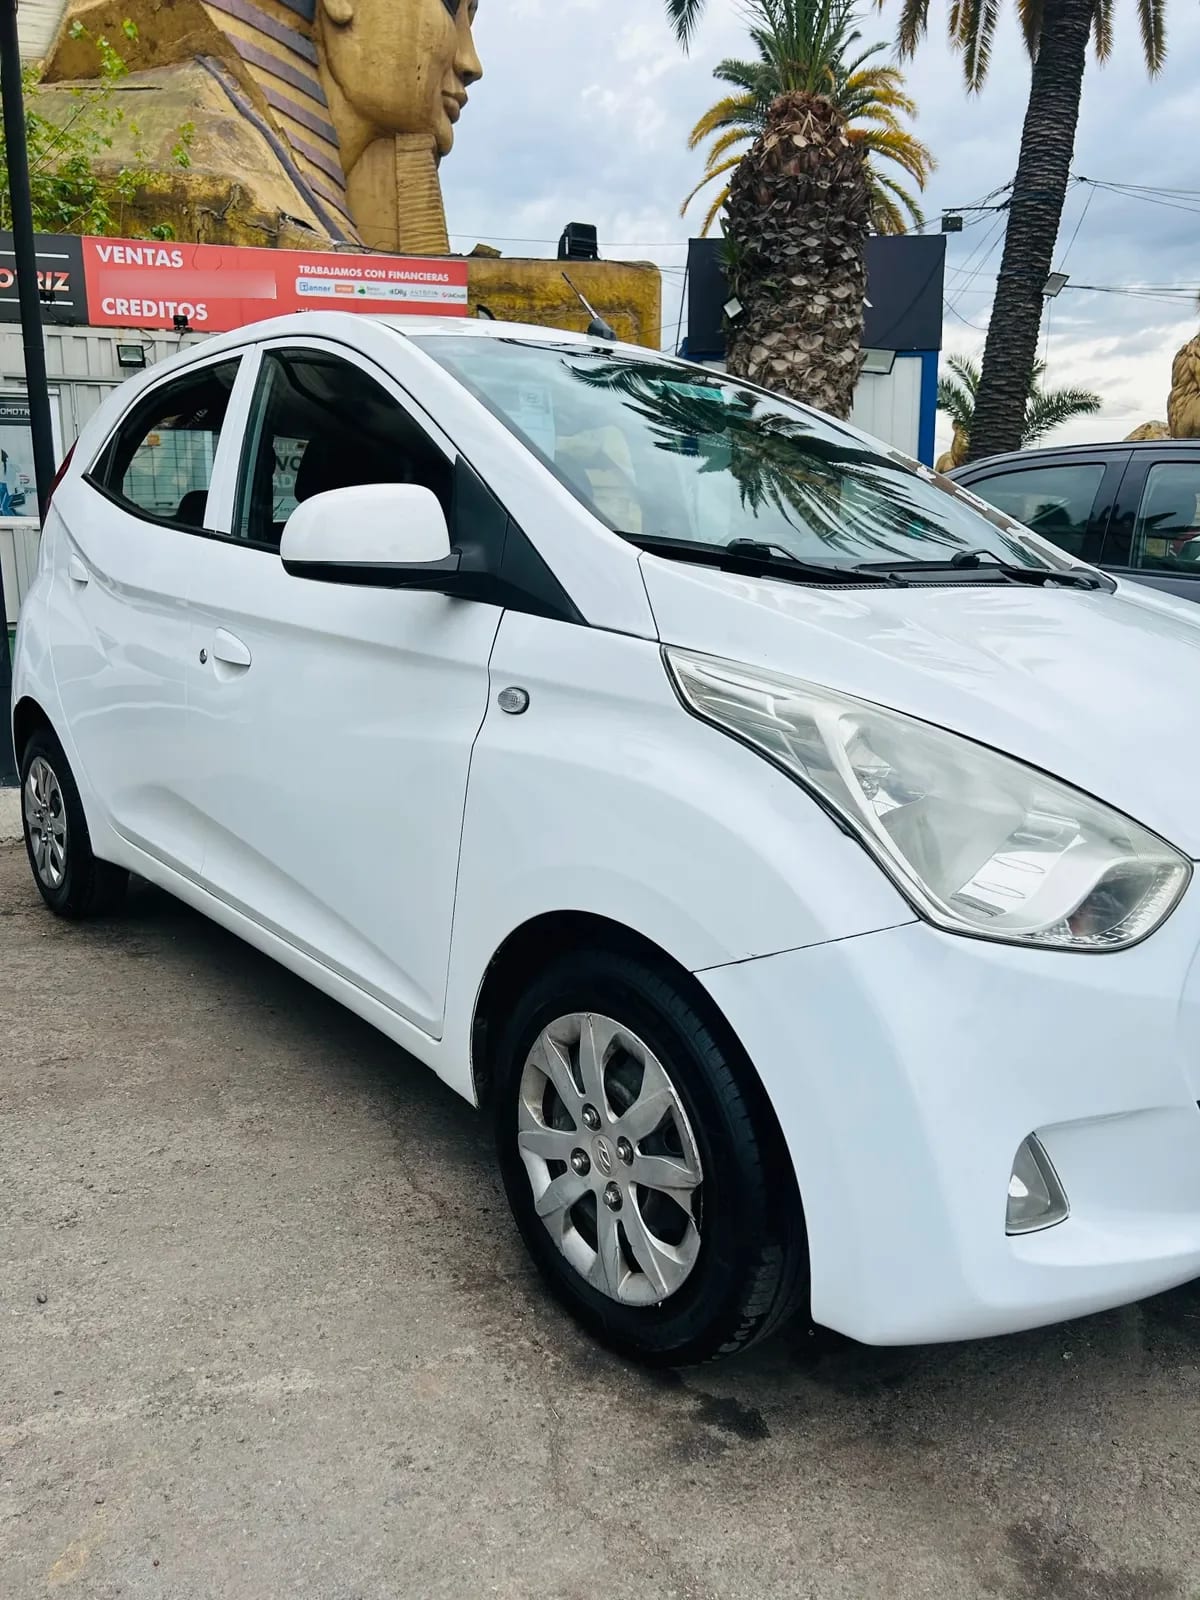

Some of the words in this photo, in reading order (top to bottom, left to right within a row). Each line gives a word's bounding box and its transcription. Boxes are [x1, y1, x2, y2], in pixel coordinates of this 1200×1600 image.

[96, 245, 183, 268] VENTAS
[298, 265, 363, 277] TRABAJAMOS
[364, 270, 386, 279] CON
[388, 271, 449, 282] FINANCIERAS
[102, 298, 208, 321] CREDITOS
